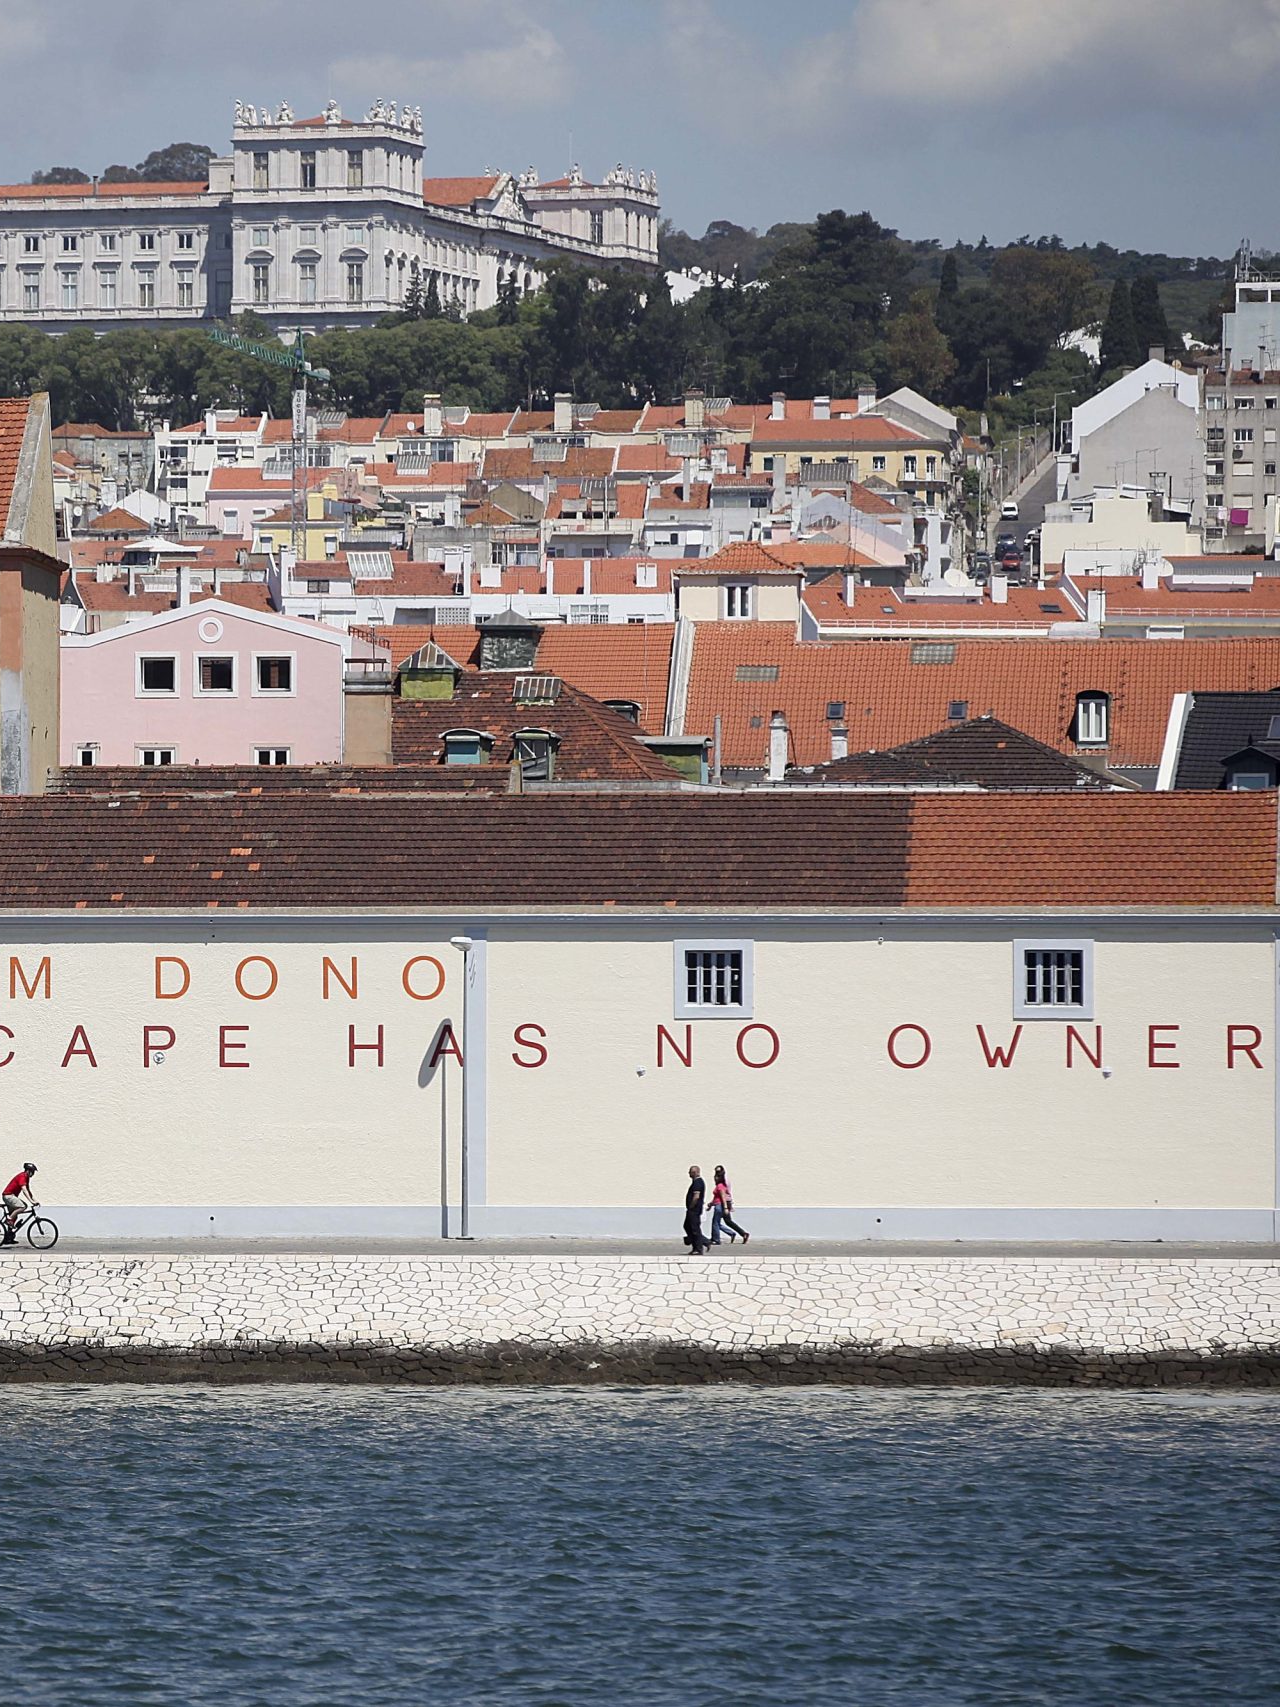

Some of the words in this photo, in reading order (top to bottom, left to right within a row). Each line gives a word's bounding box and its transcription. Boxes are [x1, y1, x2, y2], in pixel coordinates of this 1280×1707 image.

[155, 954, 446, 1002] DONO
[349, 1024, 549, 1069] HAS
[657, 1023, 781, 1069] NO
[888, 1023, 1263, 1069] OWNER
